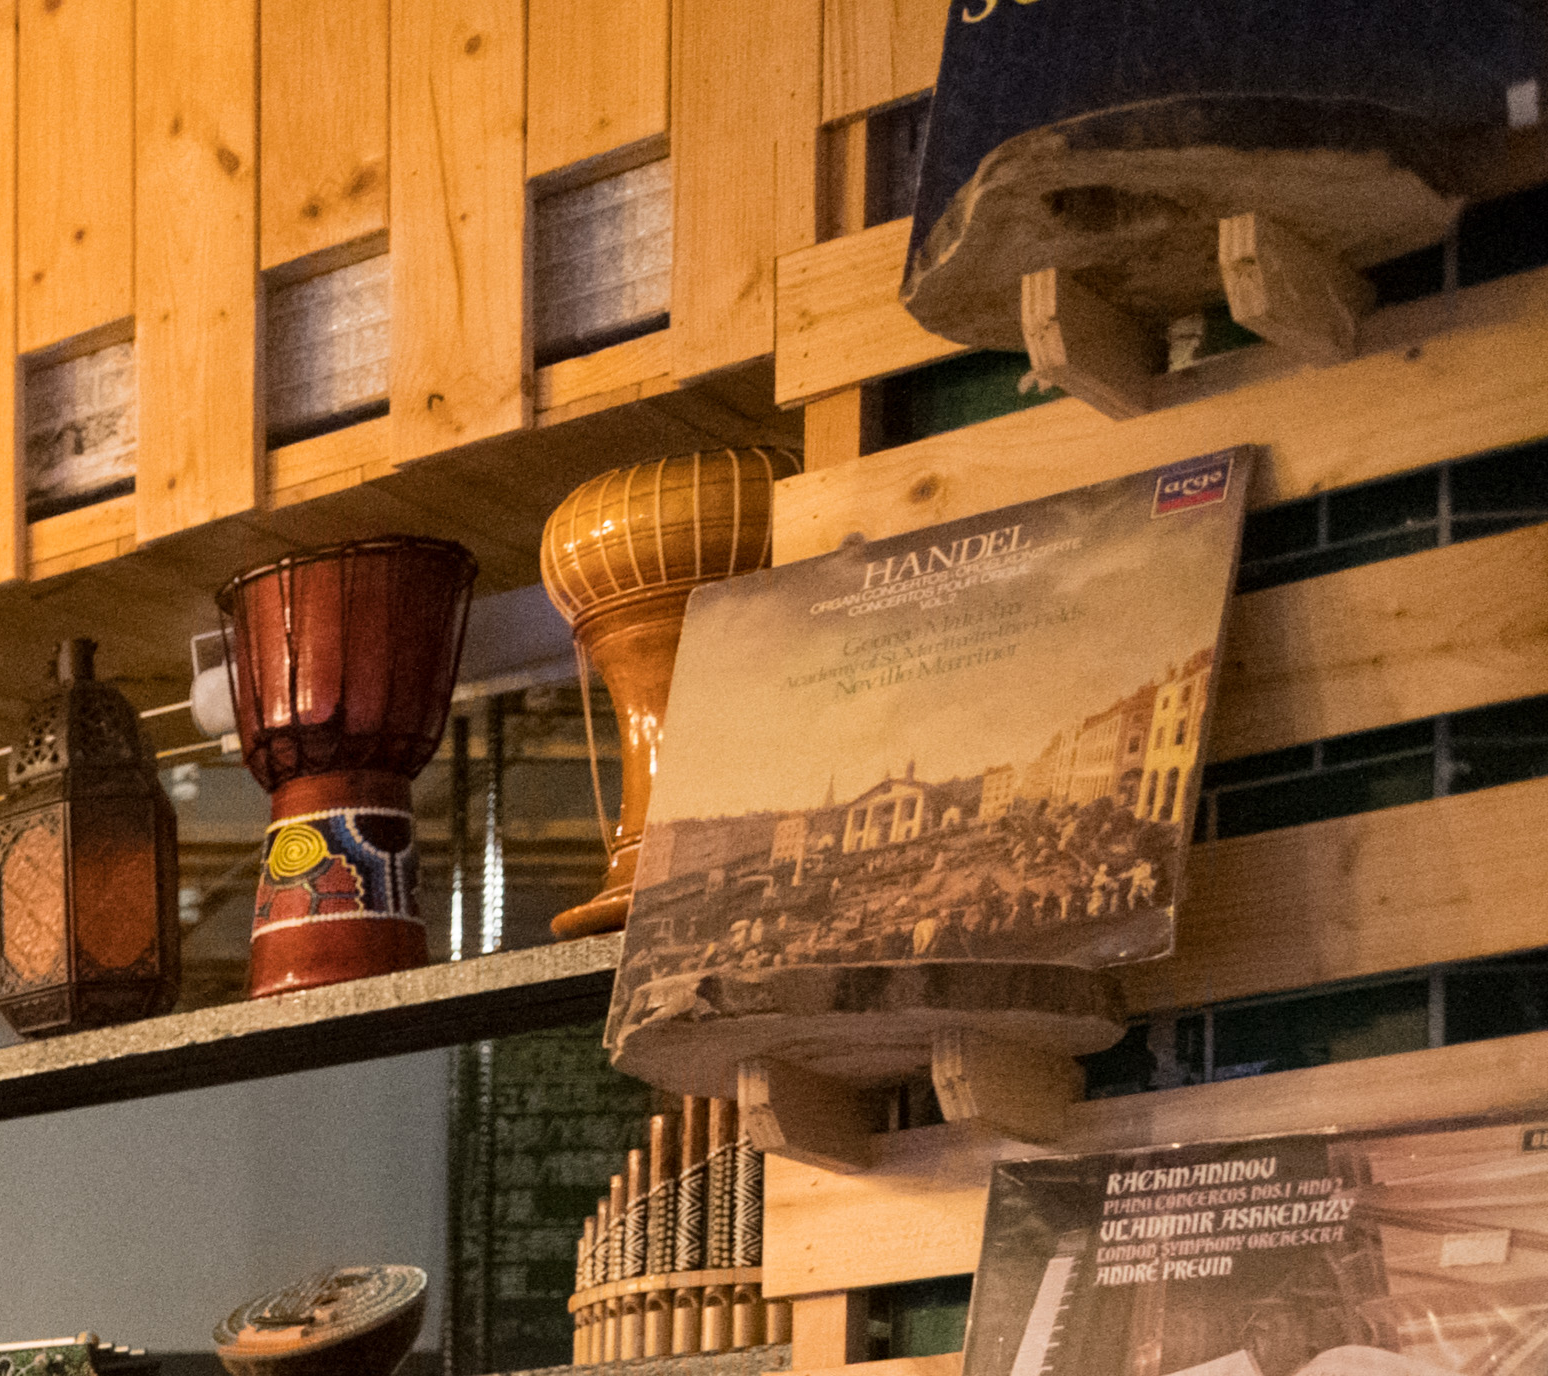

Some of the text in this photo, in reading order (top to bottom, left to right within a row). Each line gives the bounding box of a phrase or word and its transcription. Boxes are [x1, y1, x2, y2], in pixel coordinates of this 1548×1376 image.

[1159, 463, 1229, 498] argo
[862, 525, 1031, 589] HANDEL
[809, 594, 862, 615] ORGAN
[863, 575, 948, 604] CONCERTOS
[849, 590, 935, 617] CONCERTOS
[1107, 1156, 1278, 1196] RACHMANINOV
[1100, 1198, 1356, 1243] VLADIMIR ASHKENAZY
[1162, 1256, 1234, 1281] PREVIN
